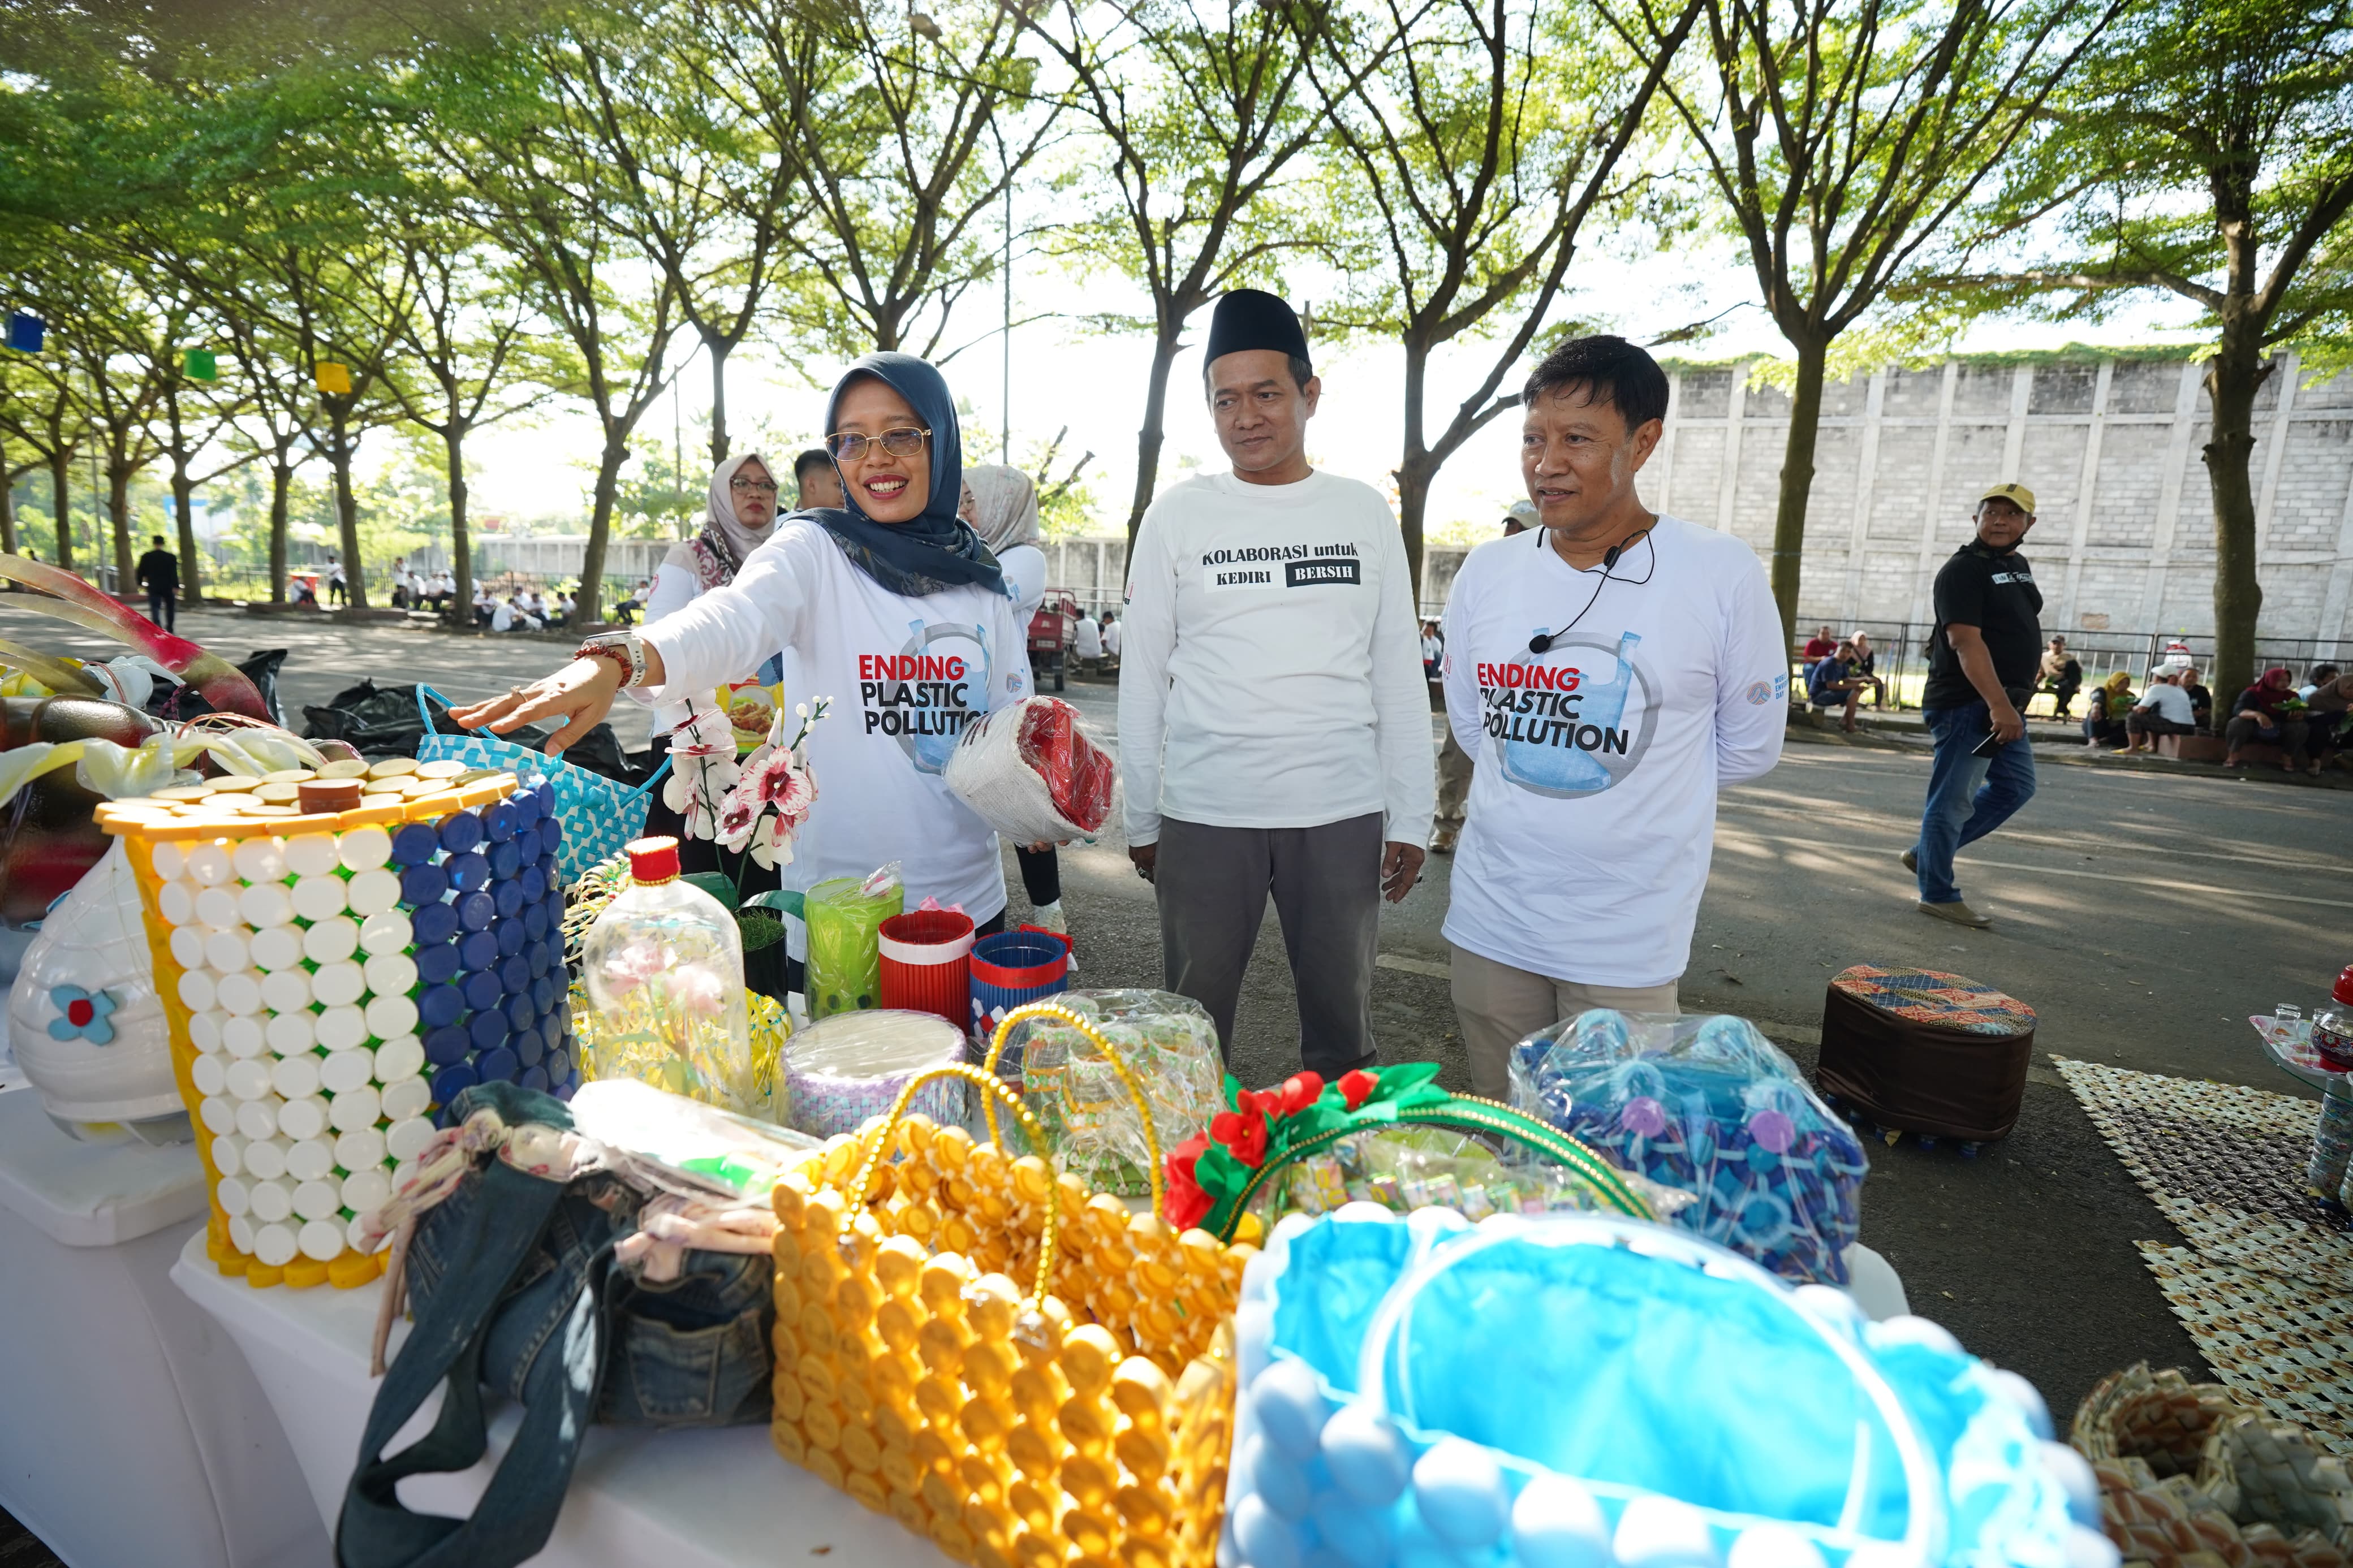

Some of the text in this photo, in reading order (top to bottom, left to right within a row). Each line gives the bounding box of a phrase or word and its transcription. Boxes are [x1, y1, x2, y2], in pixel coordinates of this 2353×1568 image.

[1203, 542, 1359, 565] KOLABORASI untuk
[1217, 565, 1354, 585] KEDIRI BERSIH
[859, 654, 965, 681] ENDING
[1477, 663, 1580, 692] ENDING
[860, 682, 968, 707] PLASTIC
[1480, 687, 1584, 719] PLASTIC
[864, 710, 988, 736] POLLUTI
[1483, 711, 1629, 755] POLLUTION
